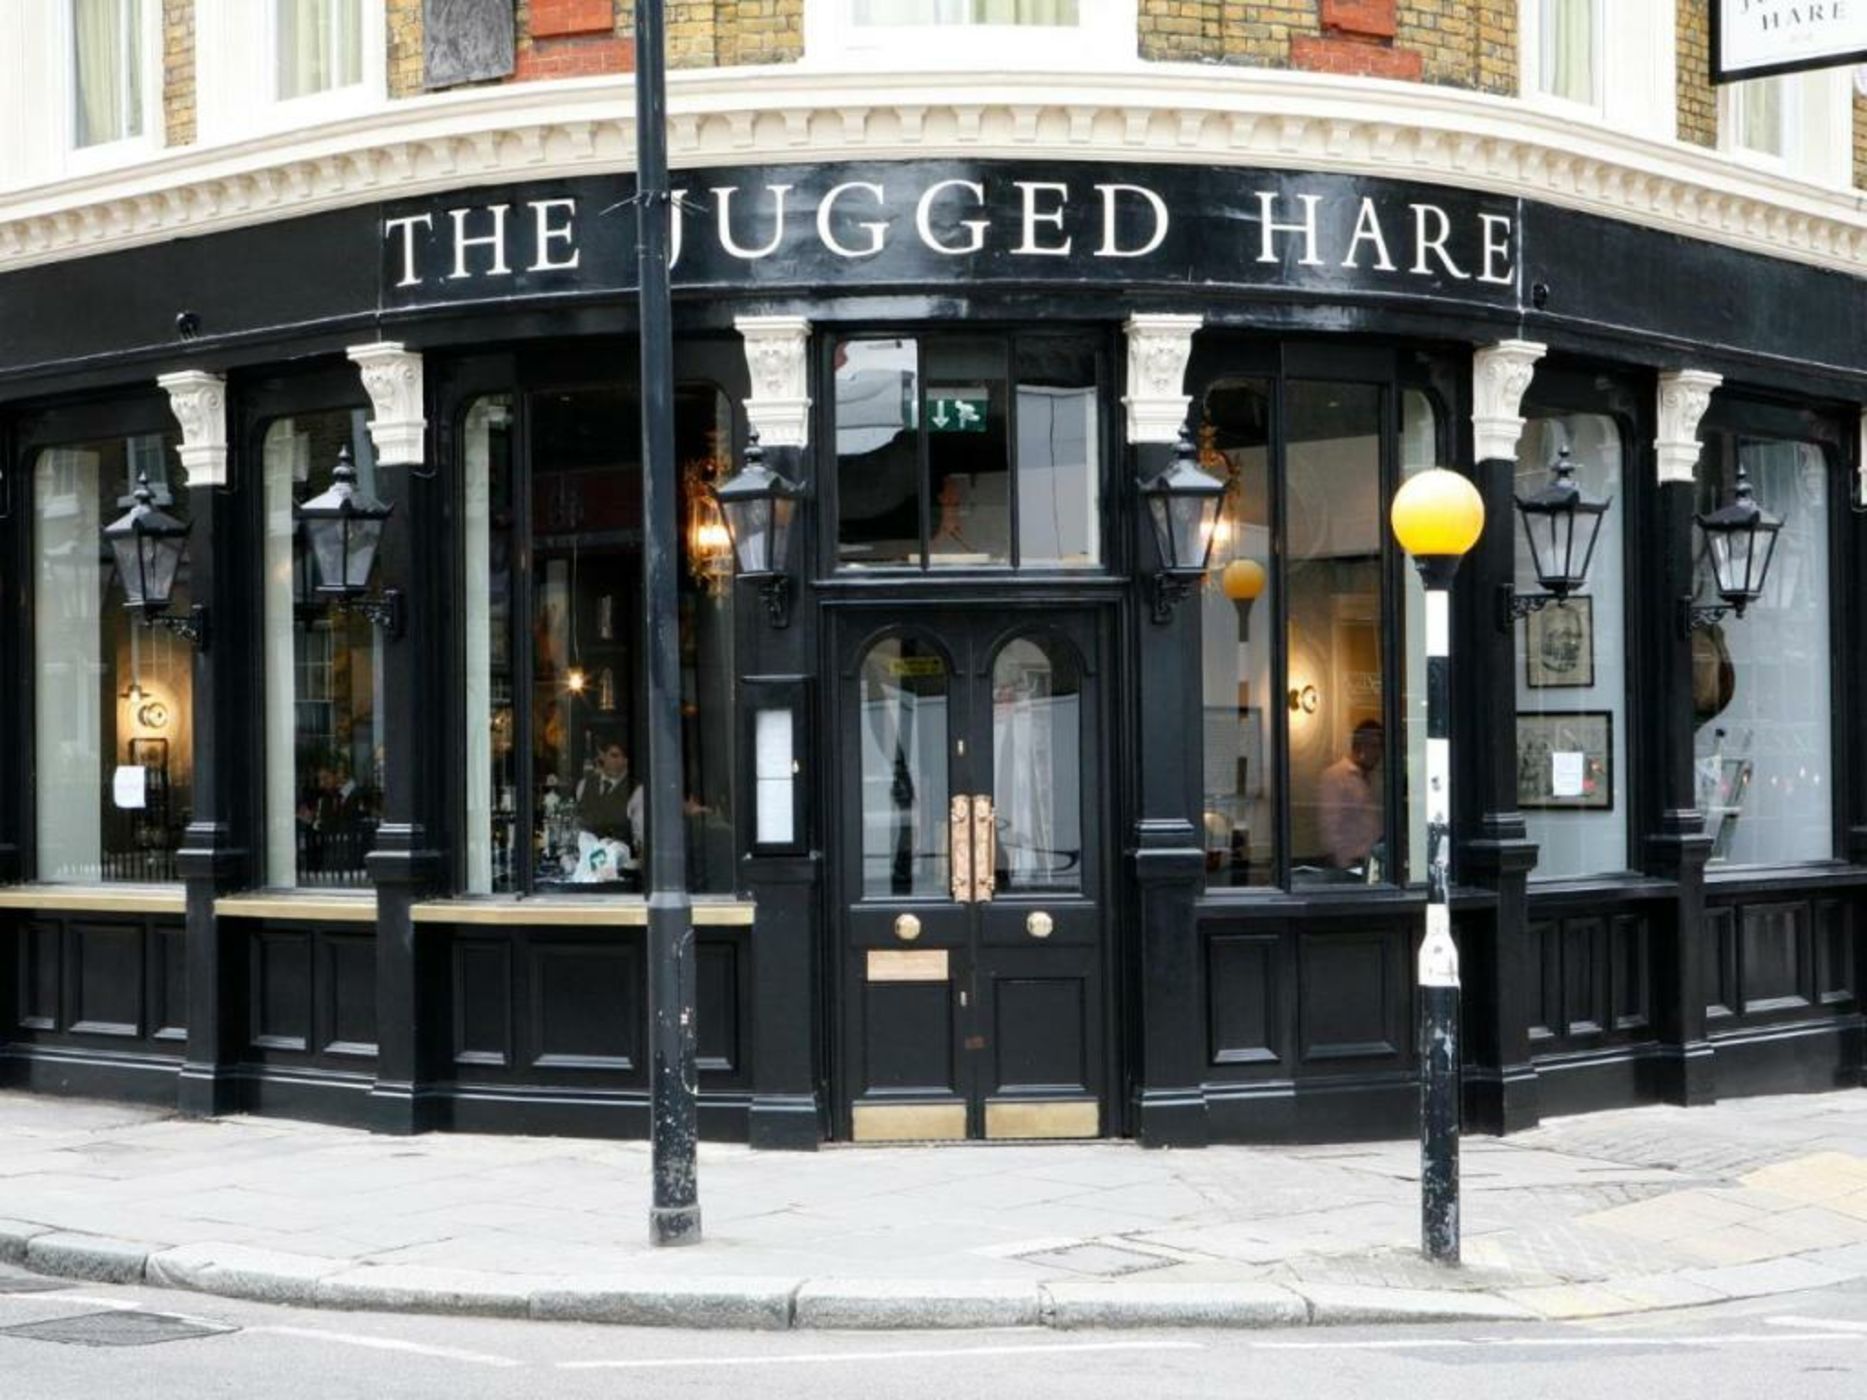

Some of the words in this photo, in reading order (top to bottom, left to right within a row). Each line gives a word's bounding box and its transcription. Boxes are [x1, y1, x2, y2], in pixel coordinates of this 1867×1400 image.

[1761, 2, 1845, 31] HARE
[384, 197, 581, 288] THE
[668, 179, 1170, 270] JUGGED
[1253, 190, 1516, 287] HARE
